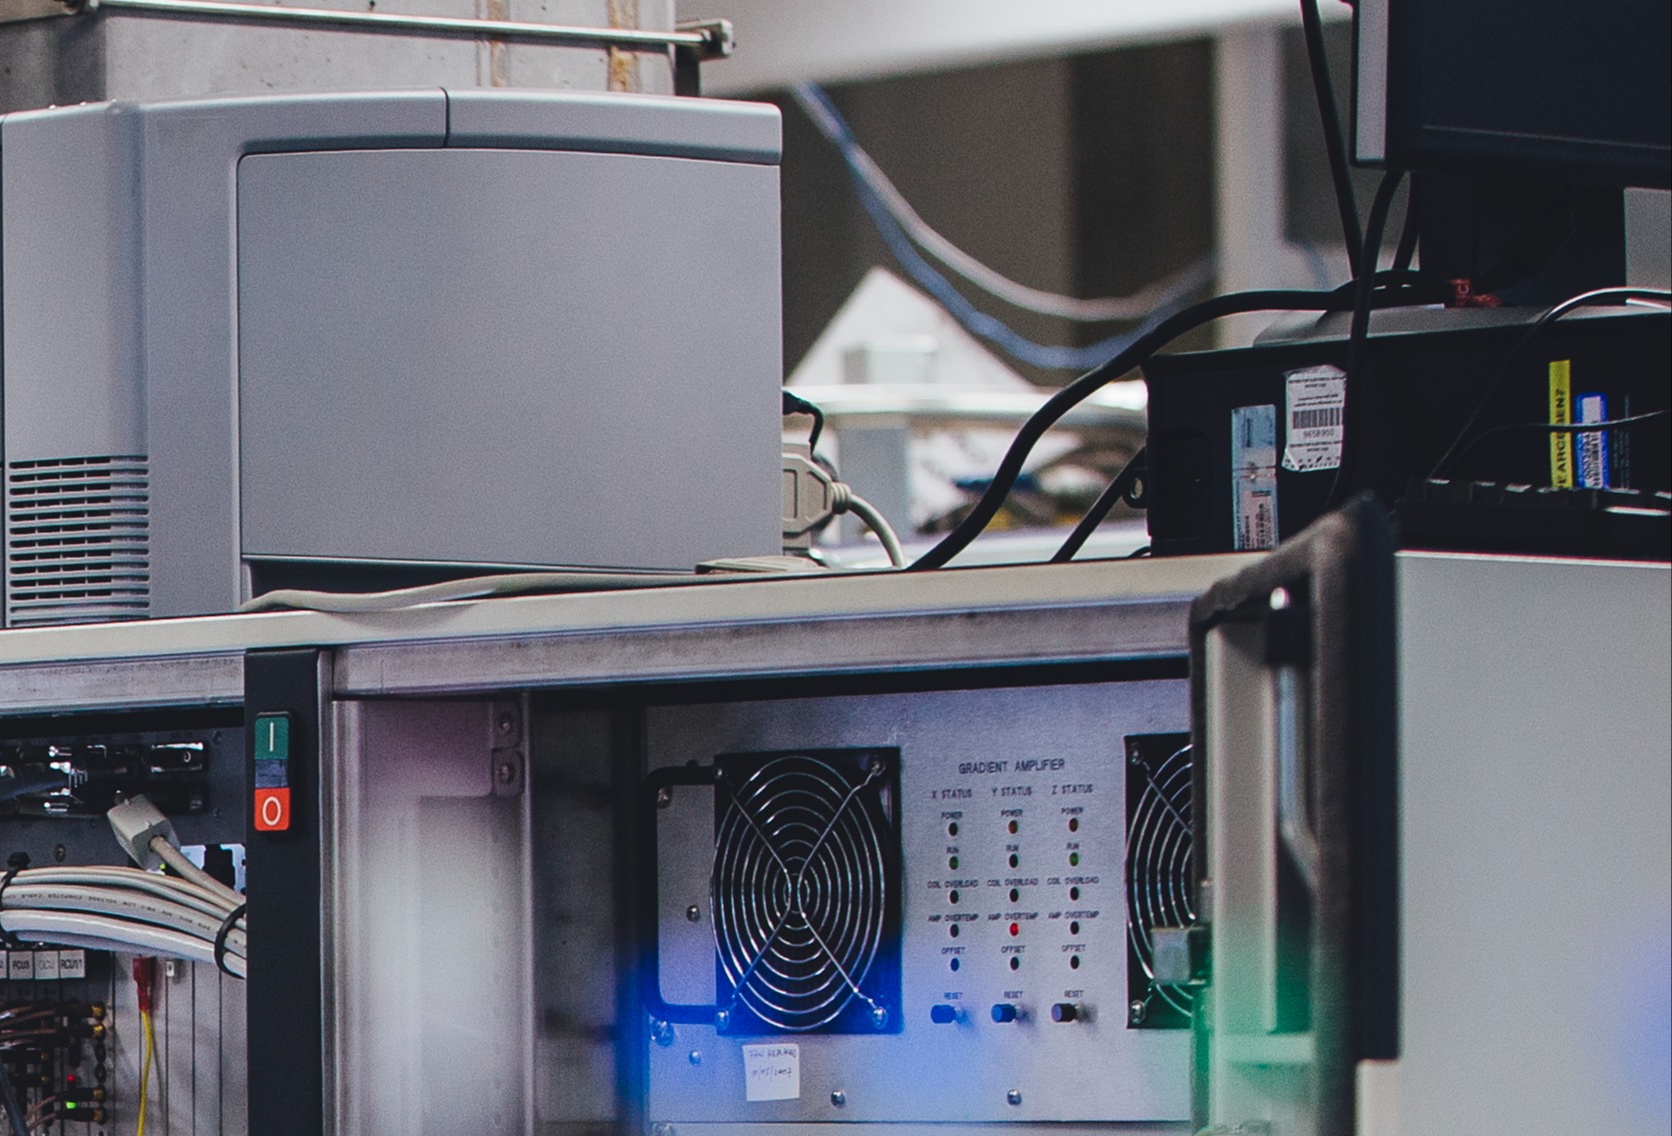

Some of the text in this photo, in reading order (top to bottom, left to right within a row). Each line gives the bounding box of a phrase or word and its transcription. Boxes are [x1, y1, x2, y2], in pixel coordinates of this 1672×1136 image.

[959, 758, 1065, 774] GRADIENT AMPLIFIER
[931, 789, 972, 799] X STATUS
[992, 786, 1032, 797] Y STATUS
[1051, 784, 1093, 795] Z STATUS
